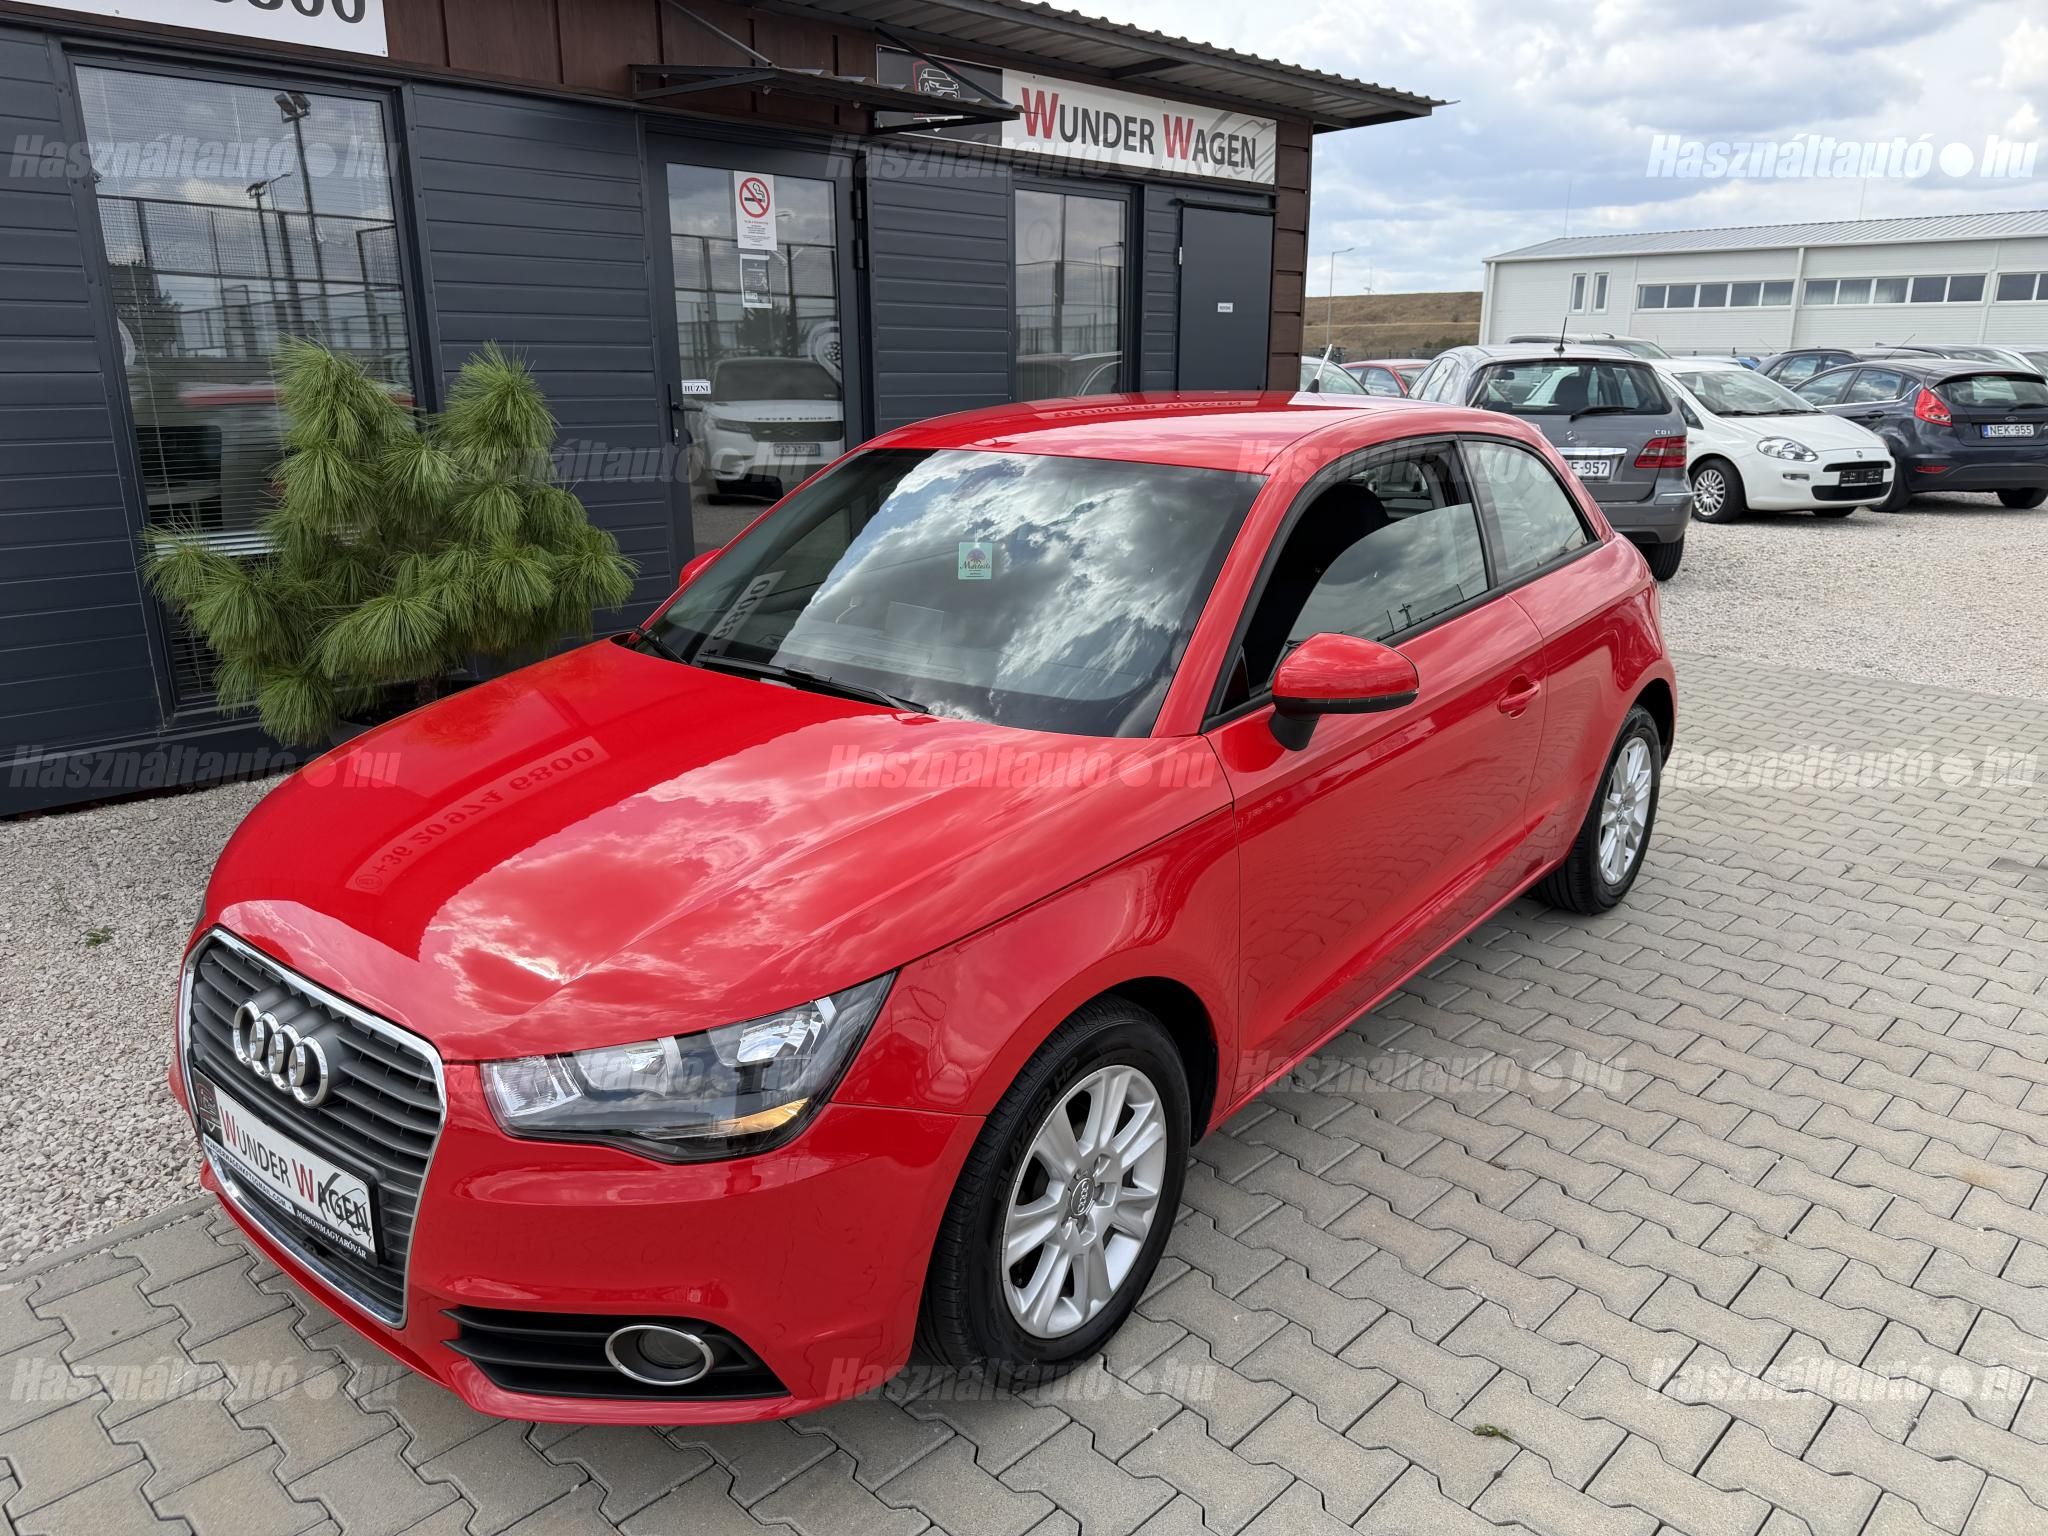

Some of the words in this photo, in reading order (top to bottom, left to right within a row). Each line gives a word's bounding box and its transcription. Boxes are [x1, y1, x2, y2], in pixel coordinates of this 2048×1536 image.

[1022, 87, 1155, 155] WUNDER
[1162, 113, 1257, 170] WAGEN
[1989, 425, 2032, 435] NEK-955
[1569, 461, 1608, 475] F-957
[220, 1106, 291, 1188] WUNDER
[292, 1158, 371, 1234] WAGEN
